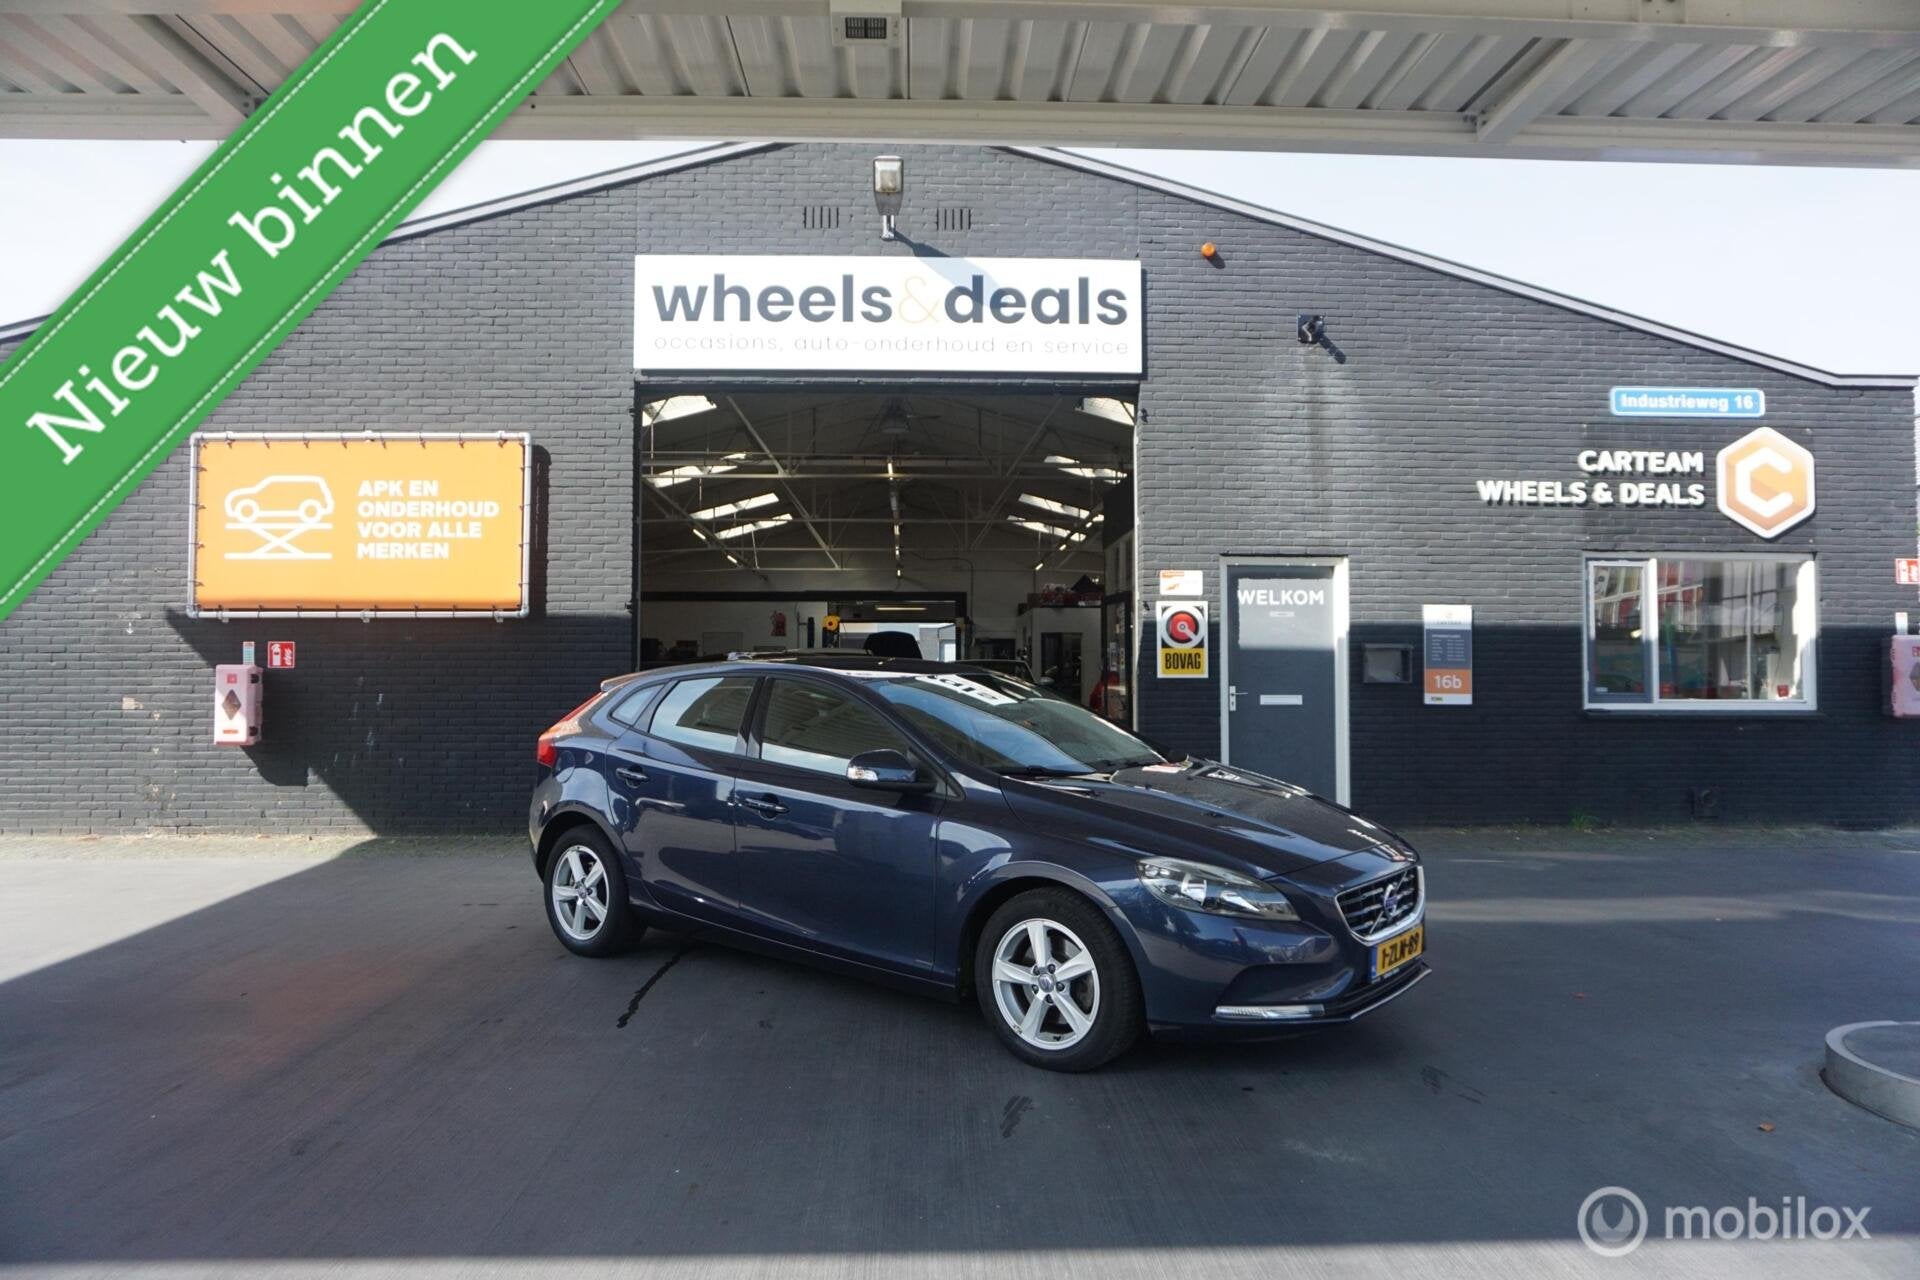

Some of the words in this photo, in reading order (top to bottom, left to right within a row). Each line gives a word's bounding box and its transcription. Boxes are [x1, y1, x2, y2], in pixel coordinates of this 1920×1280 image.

[654, 333, 785, 353] occasions,
[1005, 340, 1034, 354] en
[1043, 338, 1129, 355] service
[1621, 393, 1729, 412] Industrieweg
[1734, 395, 1753, 409] 16
[1577, 450, 1705, 474] CARTEAM
[358, 480, 404, 497] APK
[408, 480, 439, 497] EN
[1476, 480, 1587, 504] WHEELS
[1592, 482, 1614, 504] &
[1619, 483, 1706, 506] DEALS
[357, 501, 500, 518] ONDERHOUD
[356, 521, 422, 539] VOOR
[427, 522, 482, 539] ALLE
[356, 542, 450, 560] MERKEN
[1237, 589, 1325, 606] WELKOM
[1165, 652, 1201, 670] BOVAG
[1434, 674, 1462, 689] 16b
